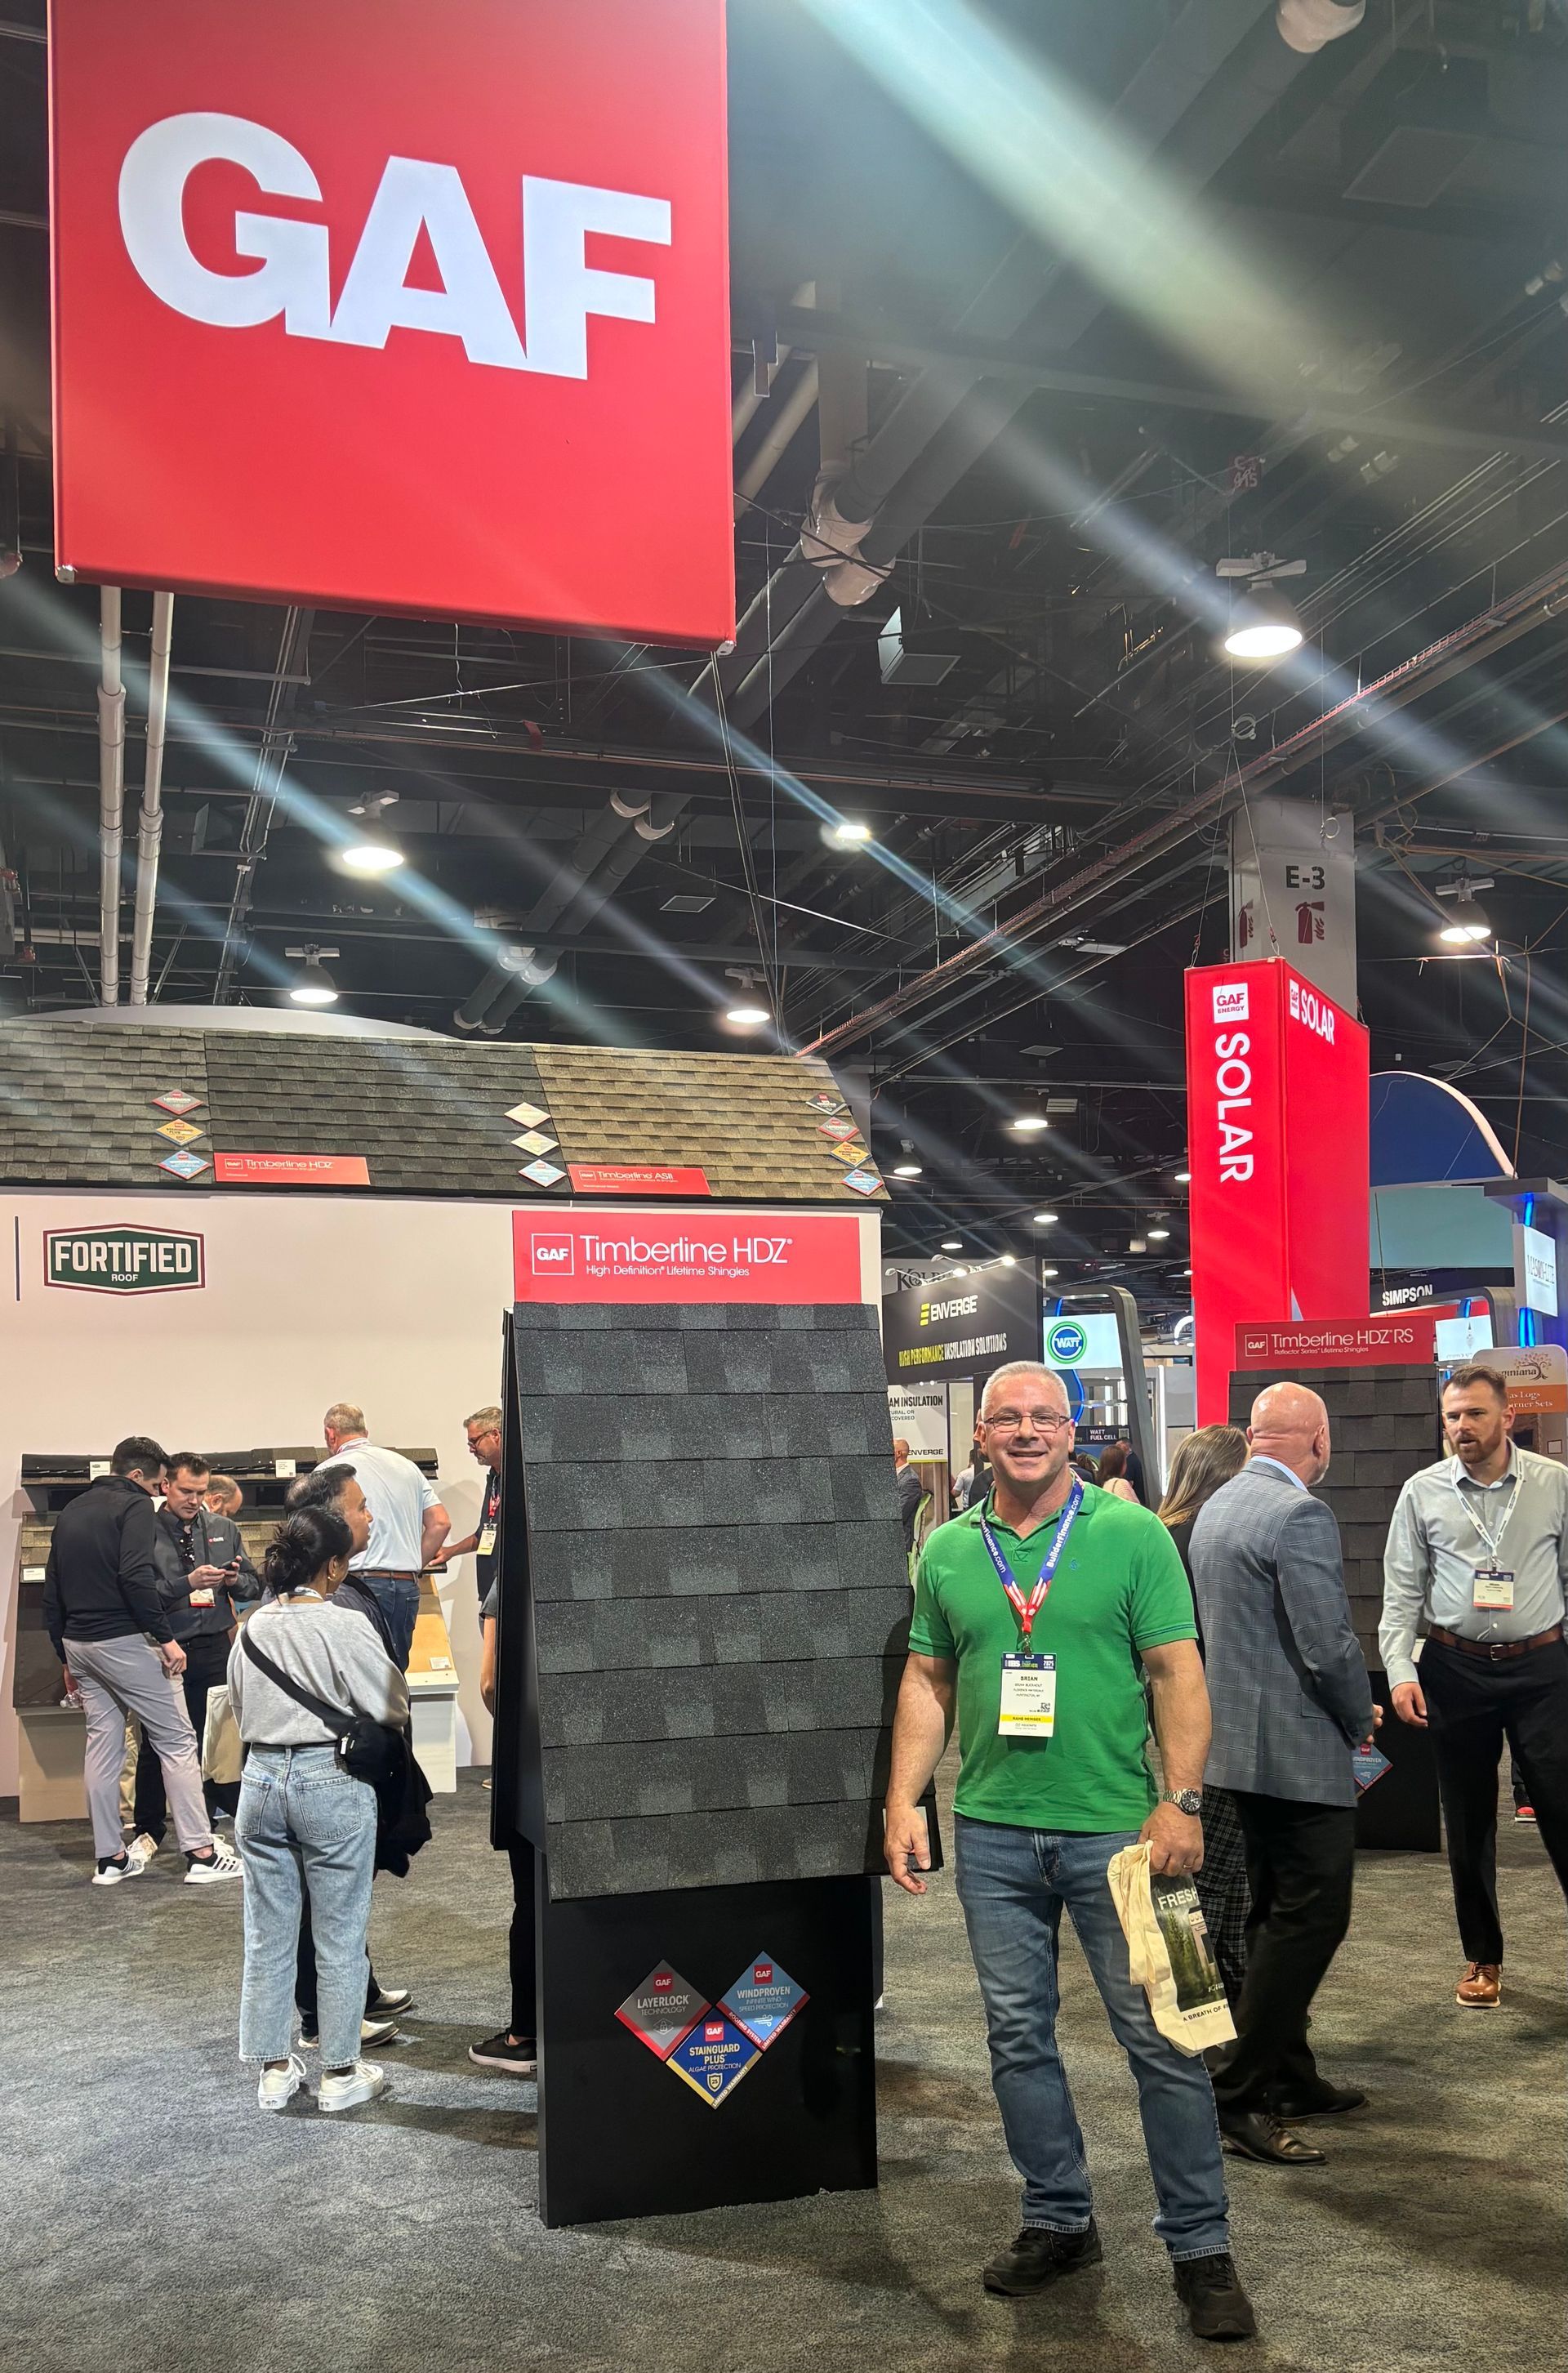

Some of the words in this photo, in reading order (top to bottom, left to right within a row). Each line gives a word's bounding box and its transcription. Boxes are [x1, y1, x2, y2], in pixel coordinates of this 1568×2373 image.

[118, 112, 672, 380] GAF
[1285, 865, 1325, 890] E-3
[1216, 992, 1245, 1007] GAF
[1218, 1005, 1245, 1014] ENERGY
[1300, 988, 1335, 1046] SOLAR
[1215, 1032, 1254, 1184] SOLAR
[244, 1159, 307, 1168] Timberline
[597, 1171, 653, 1180] Timberline
[536, 1247, 569, 1261] GAF
[579, 1234, 727, 1263] Timberline
[55, 1241, 193, 1273] FORTIFIED
[111, 1273, 139, 1282] ROOF
[586, 1265, 611, 1276] High
[666, 1265, 706, 1276] Lifetime
[707, 1266, 750, 1278] Shingles
[1382, 1283, 1433, 1306] SIMPSON
[930, 1295, 978, 1322] ENVERGE
[1054, 1336, 1080, 1348] WATT
[1248, 1340, 1266, 1349] GAF
[1271, 1331, 1354, 1348] Timberline
[1393, 1328, 1414, 1344] RS
[911, 1344, 944, 1365] PERFORMANCE
[944, 1338, 976, 1360] INSULATION
[975, 1332, 1007, 1356] SOLUTIONS
[901, 1395, 943, 1407] INSULATION
[1520, 1391, 1540, 1401] Logs
[1046, 1494, 1081, 1568] BuilderFinance.com
[1157, 1886, 1200, 1911] FRESH
[755, 1969, 772, 1978] GAF
[655, 1978, 672, 1987] GAF
[641, 2006, 686, 2016] TECHNOLOGY
[739, 2004, 755, 2012] SPEED
[755, 2001, 789, 2011] PROTECTION
[1187, 2009, 1212, 2020] BREATH
[706, 2027, 723, 2035] GAF
[728, 2011, 746, 2032] ROOFING
[746, 2028, 762, 2045] SYSTEM
[762, 2030, 777, 2049] LIMITED
[777, 2009, 797, 2032] WARRANTY
[689, 2043, 741, 2056] STAINGUARD
[707, 2063, 742, 2071] PROTECTION
[712, 2090, 728, 2107] LIMITED
[727, 2066, 748, 2090] WARRANTY
